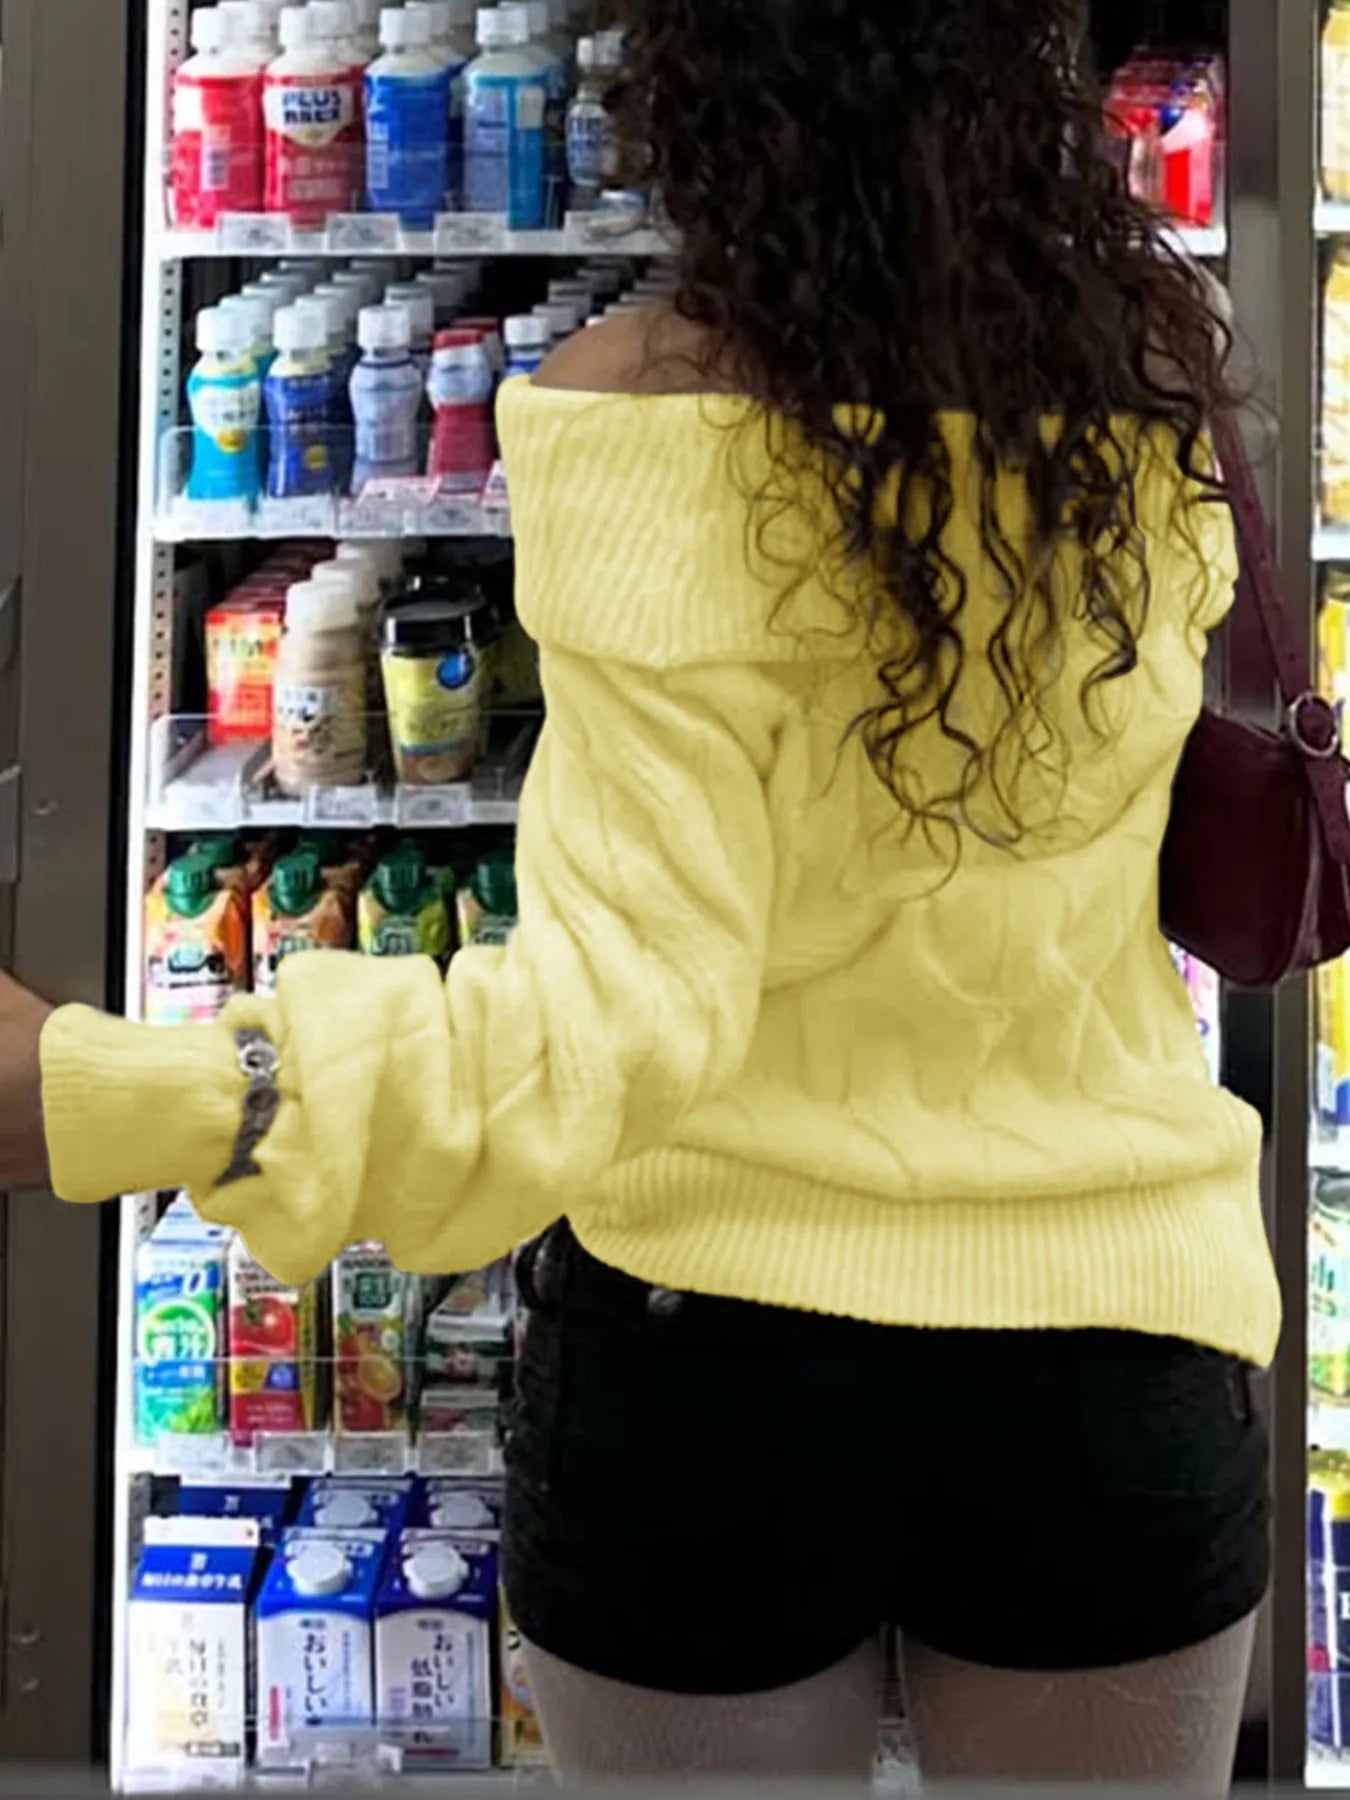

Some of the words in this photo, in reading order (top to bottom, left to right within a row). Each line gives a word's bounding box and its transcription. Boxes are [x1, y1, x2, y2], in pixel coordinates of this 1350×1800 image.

[304, 1633, 327, 1712] おいしい
[433, 1633, 455, 1708] おいしい
